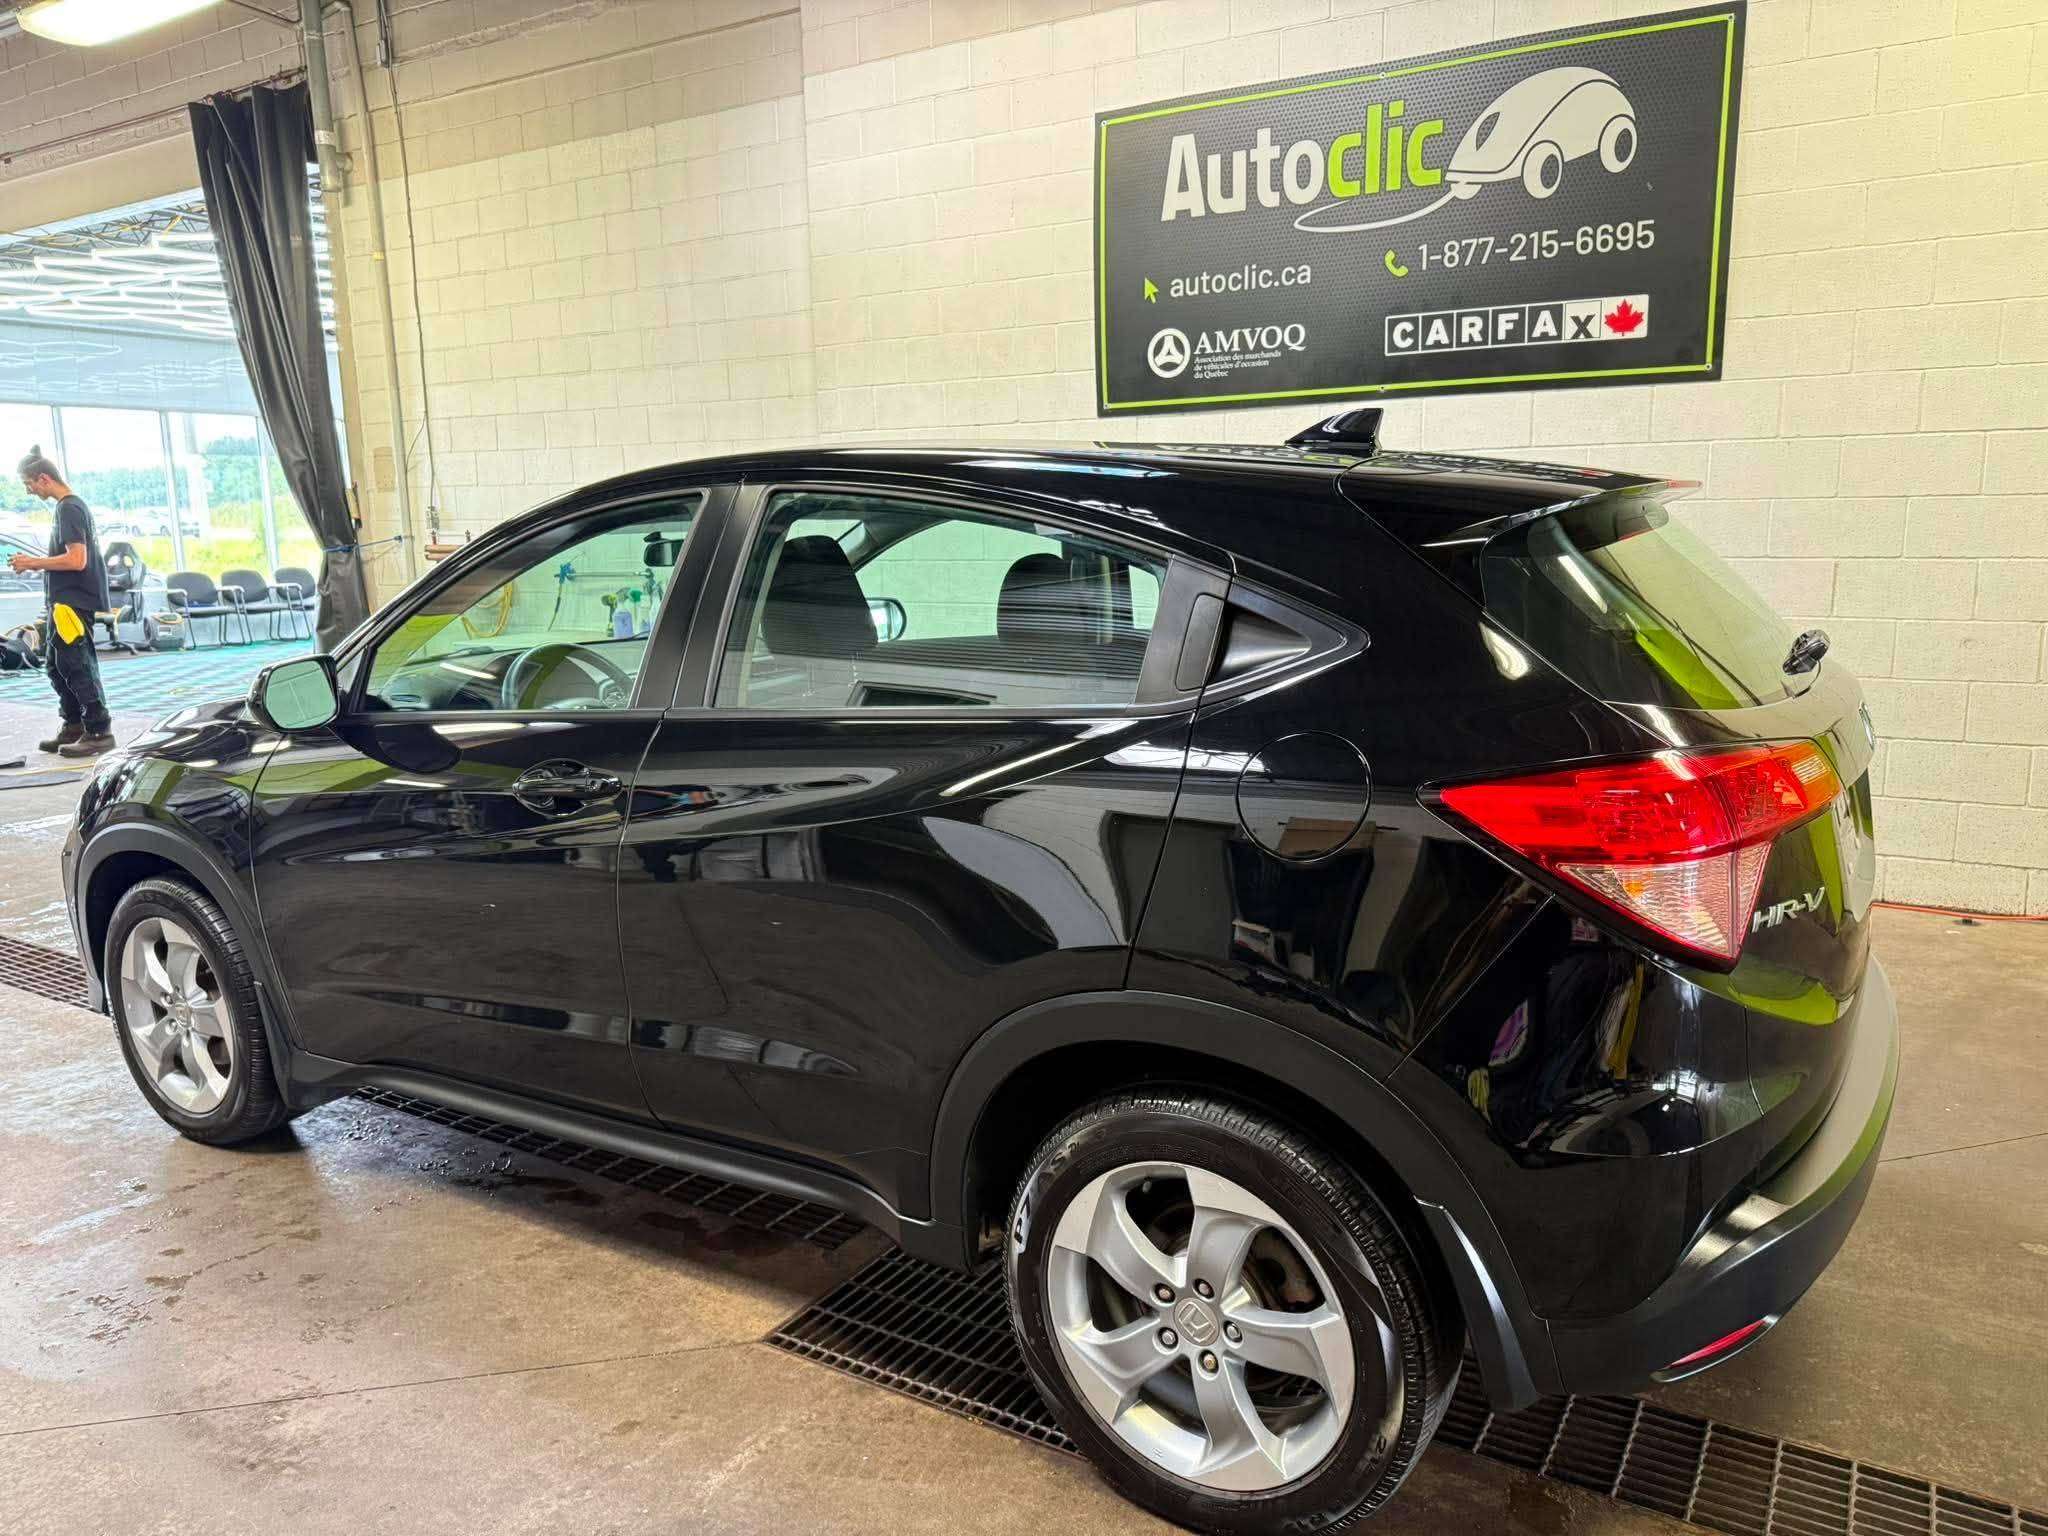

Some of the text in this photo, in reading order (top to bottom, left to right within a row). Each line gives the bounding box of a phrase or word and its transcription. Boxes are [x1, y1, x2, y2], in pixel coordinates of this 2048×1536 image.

[1161, 99, 1444, 222] Autoclic
[1417, 219, 1655, 271] 1-877-215-6695
[1170, 264, 1311, 298] autoclic.ca
[1194, 324, 1306, 354] AMVOQ
[1392, 310, 1596, 349] CARFAX
[1751, 886, 1825, 933] HR-V
